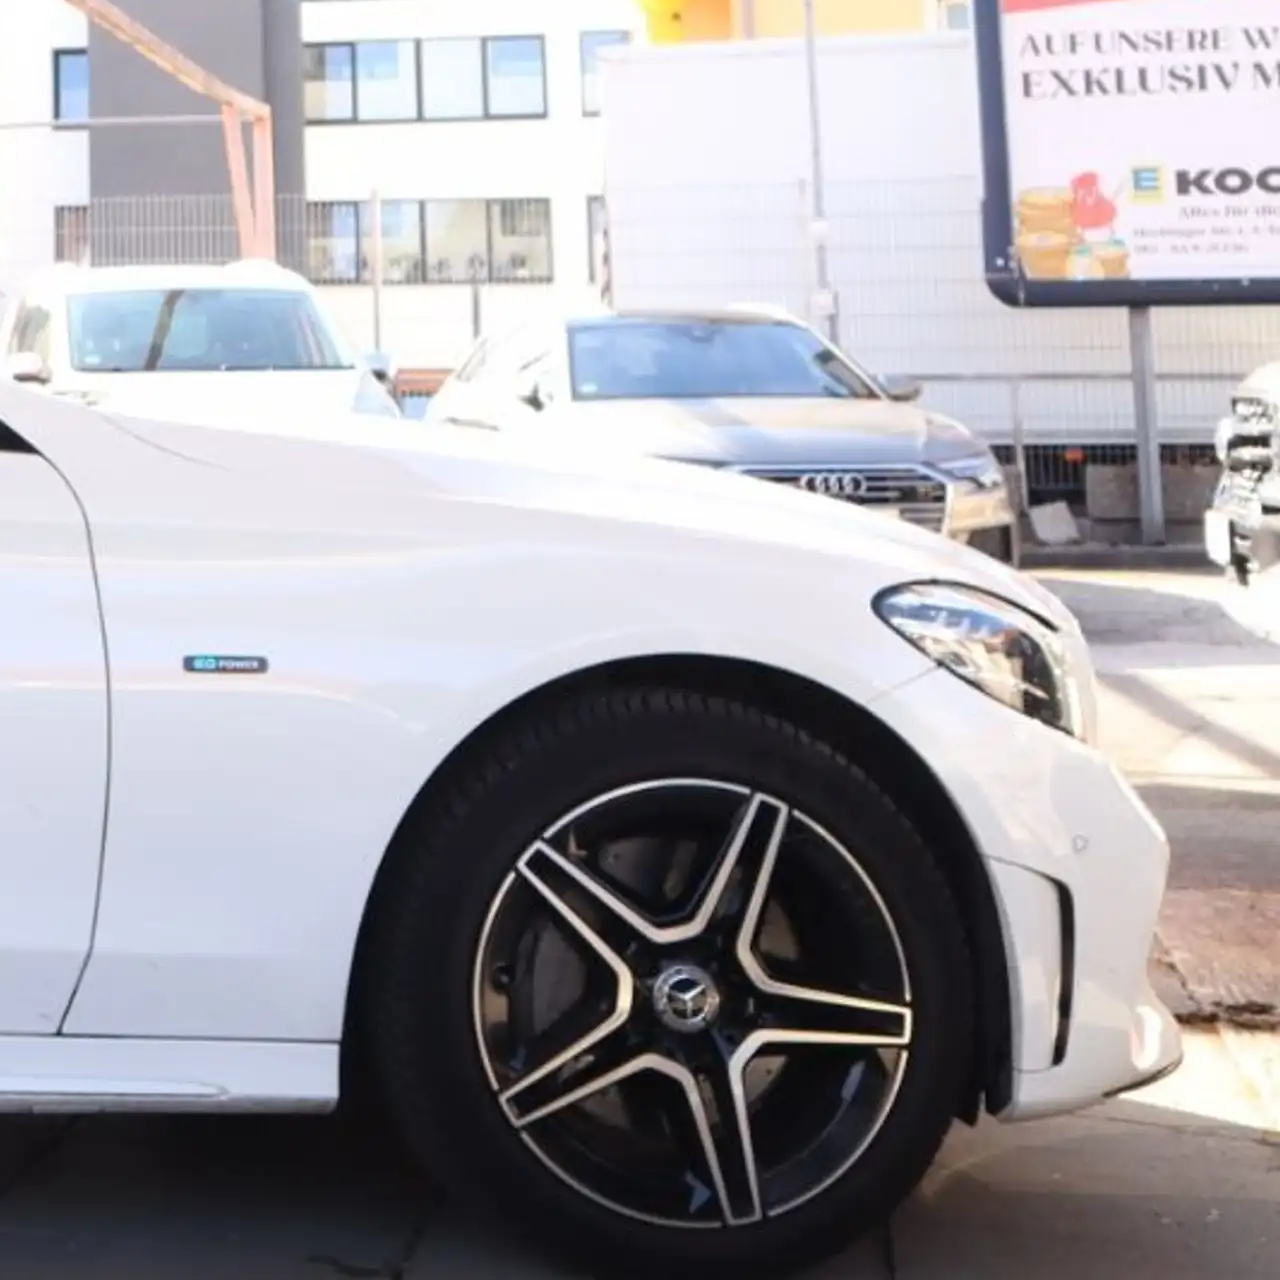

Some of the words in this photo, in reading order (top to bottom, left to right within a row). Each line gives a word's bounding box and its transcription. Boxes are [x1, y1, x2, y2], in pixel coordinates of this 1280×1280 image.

[1020, 32, 1085, 58] AUF
[1093, 27, 1234, 55] UNSERE
[1022, 61, 1239, 99] EXKLUSIV
